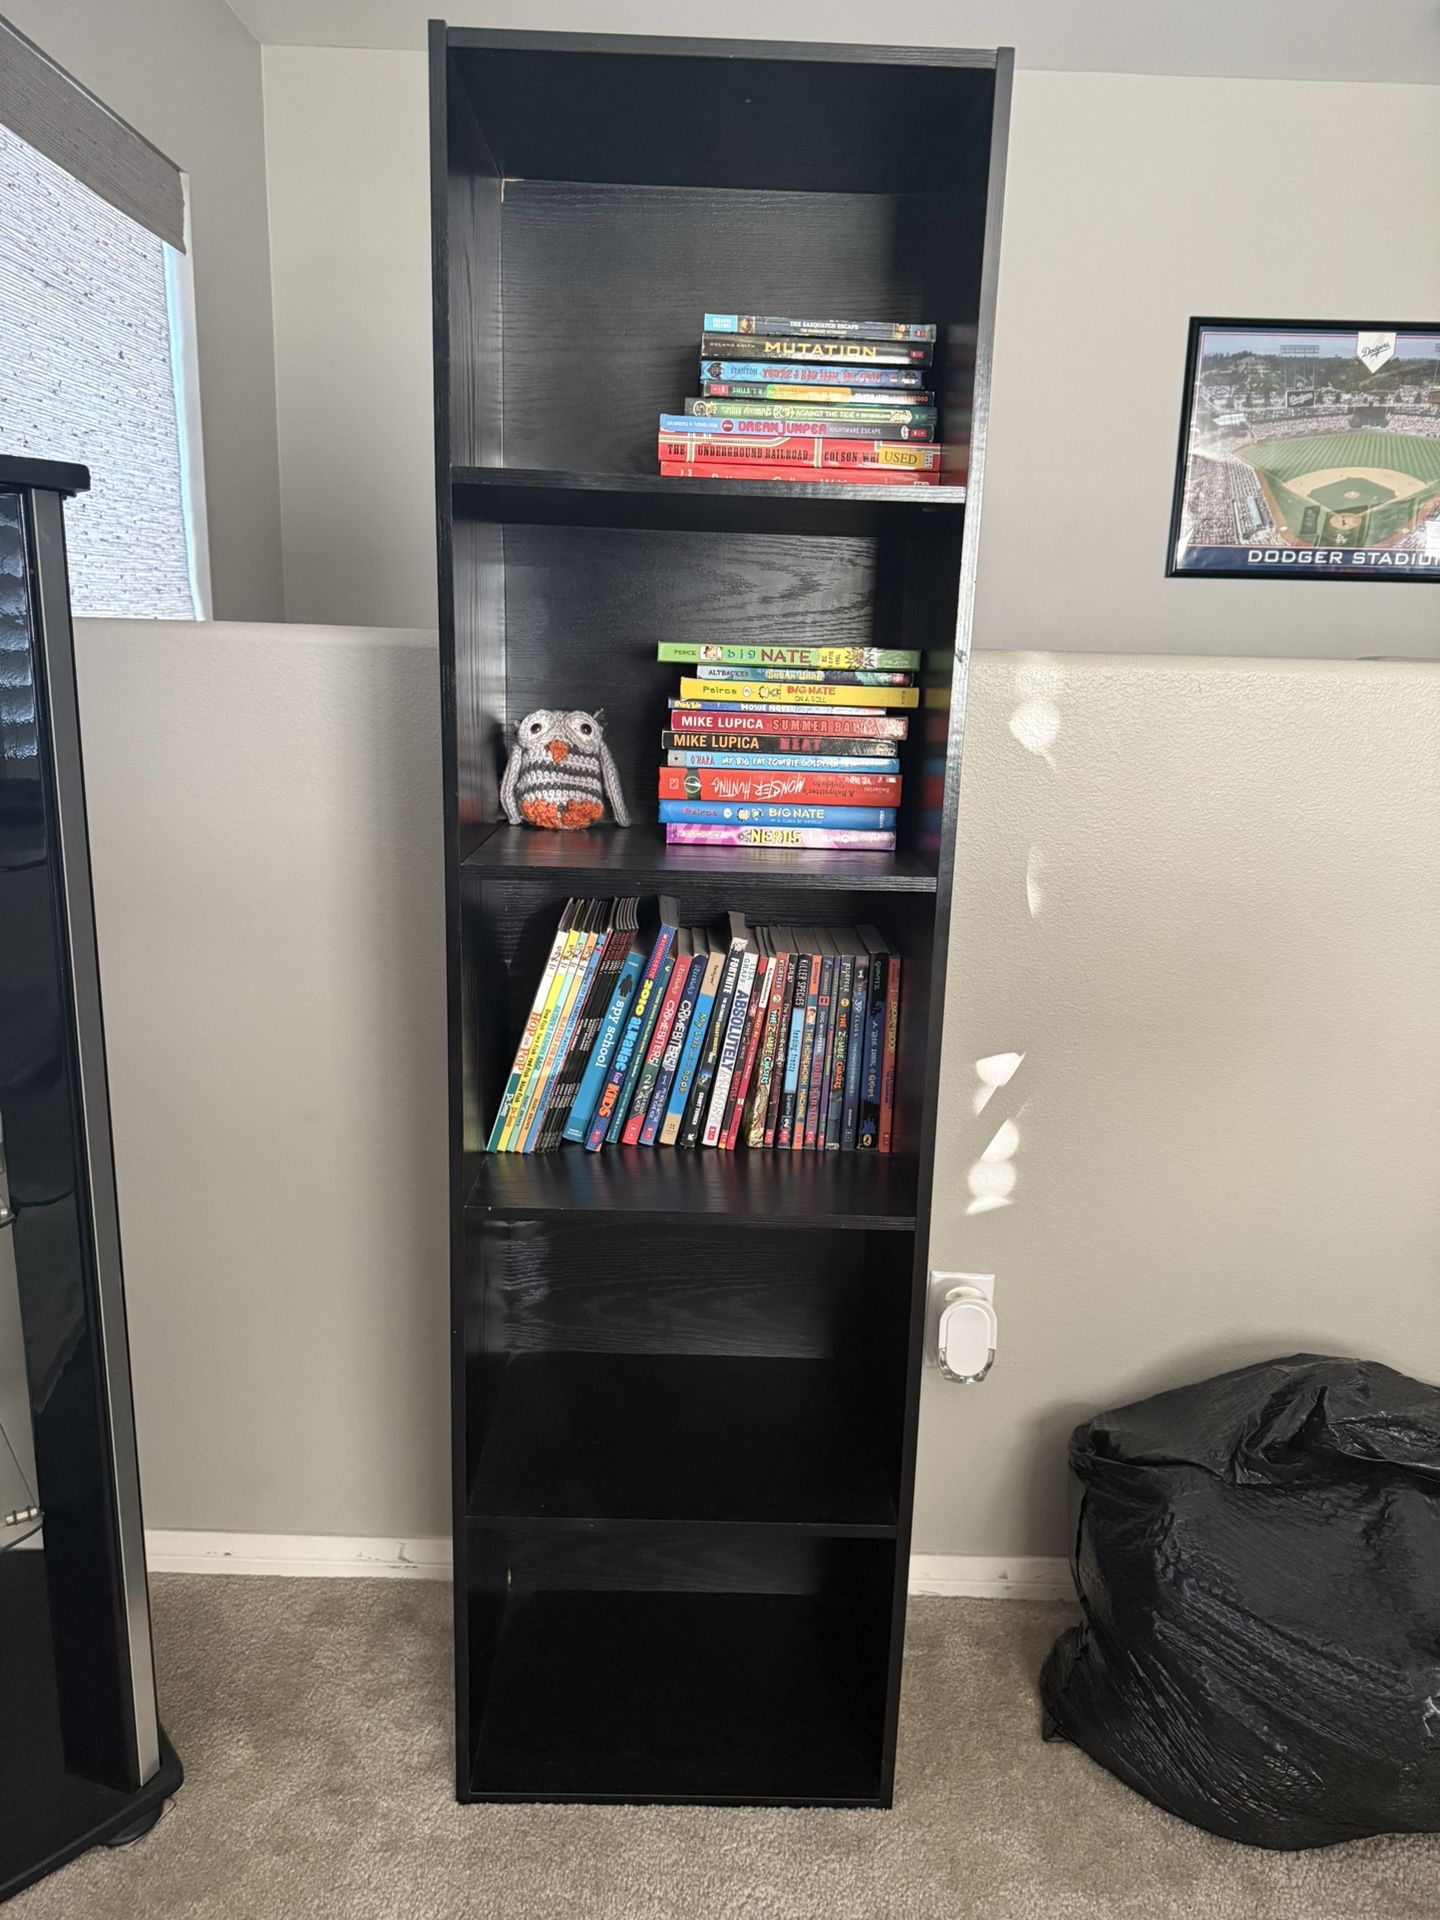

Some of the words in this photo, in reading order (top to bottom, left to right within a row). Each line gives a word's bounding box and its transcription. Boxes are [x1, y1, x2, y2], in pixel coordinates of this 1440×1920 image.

[763, 342, 876, 357] MUTATION
[1361, 340, 1391, 359] Dodgers
[738, 420, 779, 433] DREAM
[778, 420, 826, 435] JUMPER
[829, 426, 860, 434] NIGHTMARE
[861, 427, 881, 435] ESCAPE
[668, 444, 685, 455] THE
[697, 445, 763, 459] UNDERGROUND
[765, 449, 808, 461] RAILROAD
[824, 450, 857, 462] COLSON
[884, 451, 918, 464] USED
[1247, 550, 1343, 565] DODGER
[760, 648, 812, 664] NATE
[787, 685, 807, 694] BIG
[808, 686, 837, 695] NATE
[681, 715, 713, 727] MIKE
[718, 717, 764, 729] LUPICA
[772, 719, 829, 733] SUMMER
[673, 734, 707, 747] MIKE
[711, 735, 759, 749] LUPICA
[736, 757, 750, 765] BIG
[767, 757, 801, 767] ZOMBIE
[711, 777, 752, 800] HUNTING
[752, 774, 805, 800] MONSTER
[769, 808, 791, 817] BIG
[793, 809, 825, 819] NATE
[722, 957, 739, 994] FORTNITE
[738, 957, 750, 983] GRAFF
[746, 963, 756, 981] LISA
[797, 958, 809, 981] KILLER
[633, 978, 654, 1016] 2010
[794, 981, 807, 1006] SPECIES
[543, 1008, 551, 1019] One
[607, 998, 624, 1024] spy
[853, 998, 863, 1013] 39
[525, 1011, 541, 1037] HOP
[693, 1011, 708, 1029] My
[768, 1009, 779, 1024] THE
[839, 1013, 847, 1028] THE
[647, 998, 676, 1067] CRIMEBITERS!
[663, 999, 693, 1068] CRIMEBITERS!
[720, 989, 749, 1071] ABSOLUTELY
[804, 1028, 813, 1042] THE
[594, 1025, 619, 1069] school
[764, 1025, 777, 1054] ZOMBIE
[789, 1029, 800, 1051] feeding
[836, 1030, 846, 1058] ZOMBIE
[530, 1043, 538, 1055] fish
[513, 1047, 530, 1071] POP
[787, 1053, 797, 1072] frenzy
[799, 1044, 811, 1085] HOMEWORK
[522, 1067, 530, 1078] fish
[611, 1070, 622, 1084] for
[760, 1055, 772, 1085] CHASERS
[811, 1055, 821, 1086] STORM
[833, 1060, 843, 1089] CHASERS
[513, 1092, 521, 1103] fish
[538, 1081, 552, 1111] ADVENTURE
[597, 1082, 620, 1118] KIDS
[696, 1091, 704, 1107] GRANT
[796, 1088, 806, 1119] MACHINE
[808, 1087, 818, 1126] WARNING
[691, 1107, 700, 1125] TURNER
